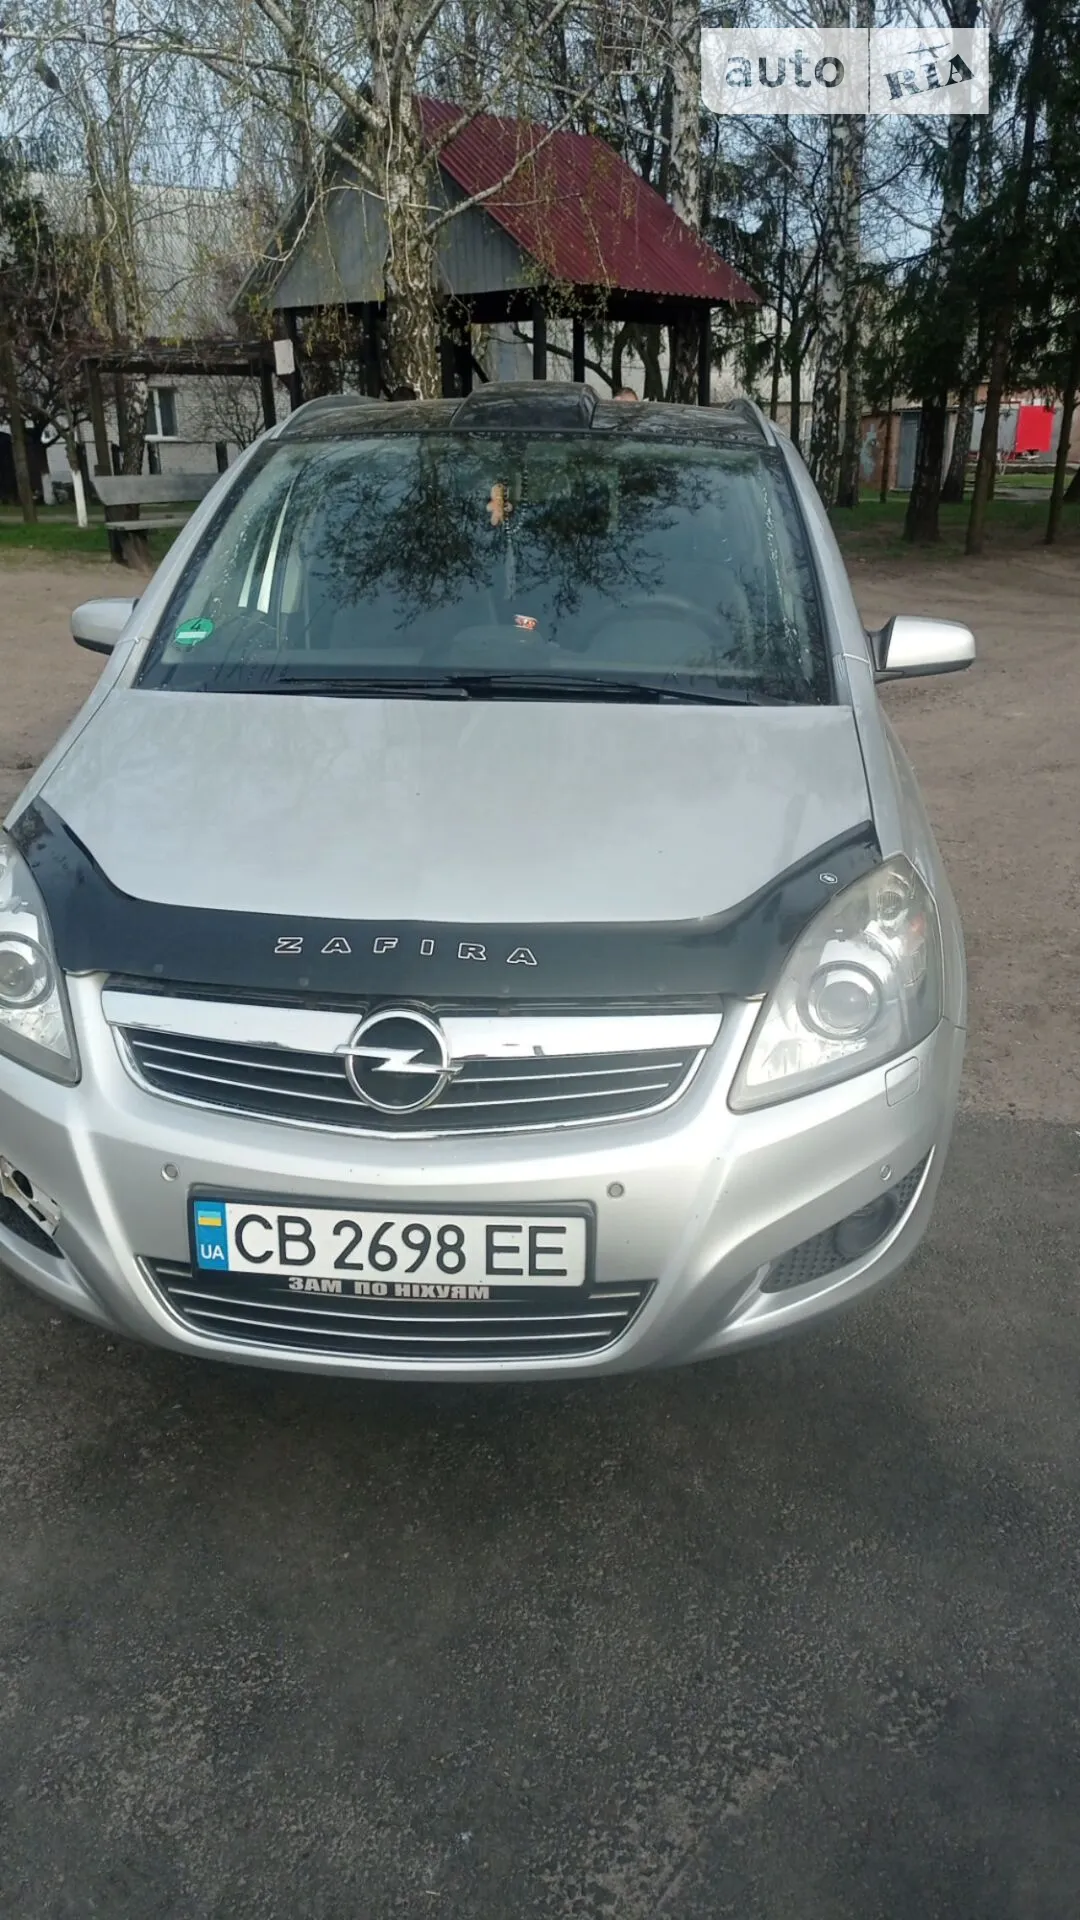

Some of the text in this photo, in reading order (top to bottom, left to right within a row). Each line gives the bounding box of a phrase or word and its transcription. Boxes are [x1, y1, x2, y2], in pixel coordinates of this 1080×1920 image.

[274, 936, 538, 966] ZAFIRA
[200, 1243, 225, 1260] UA
[234, 1213, 568, 1277] CB 2698 EE
[288, 1276, 490, 1300] ЗАМ ПО НІХУЯМ
